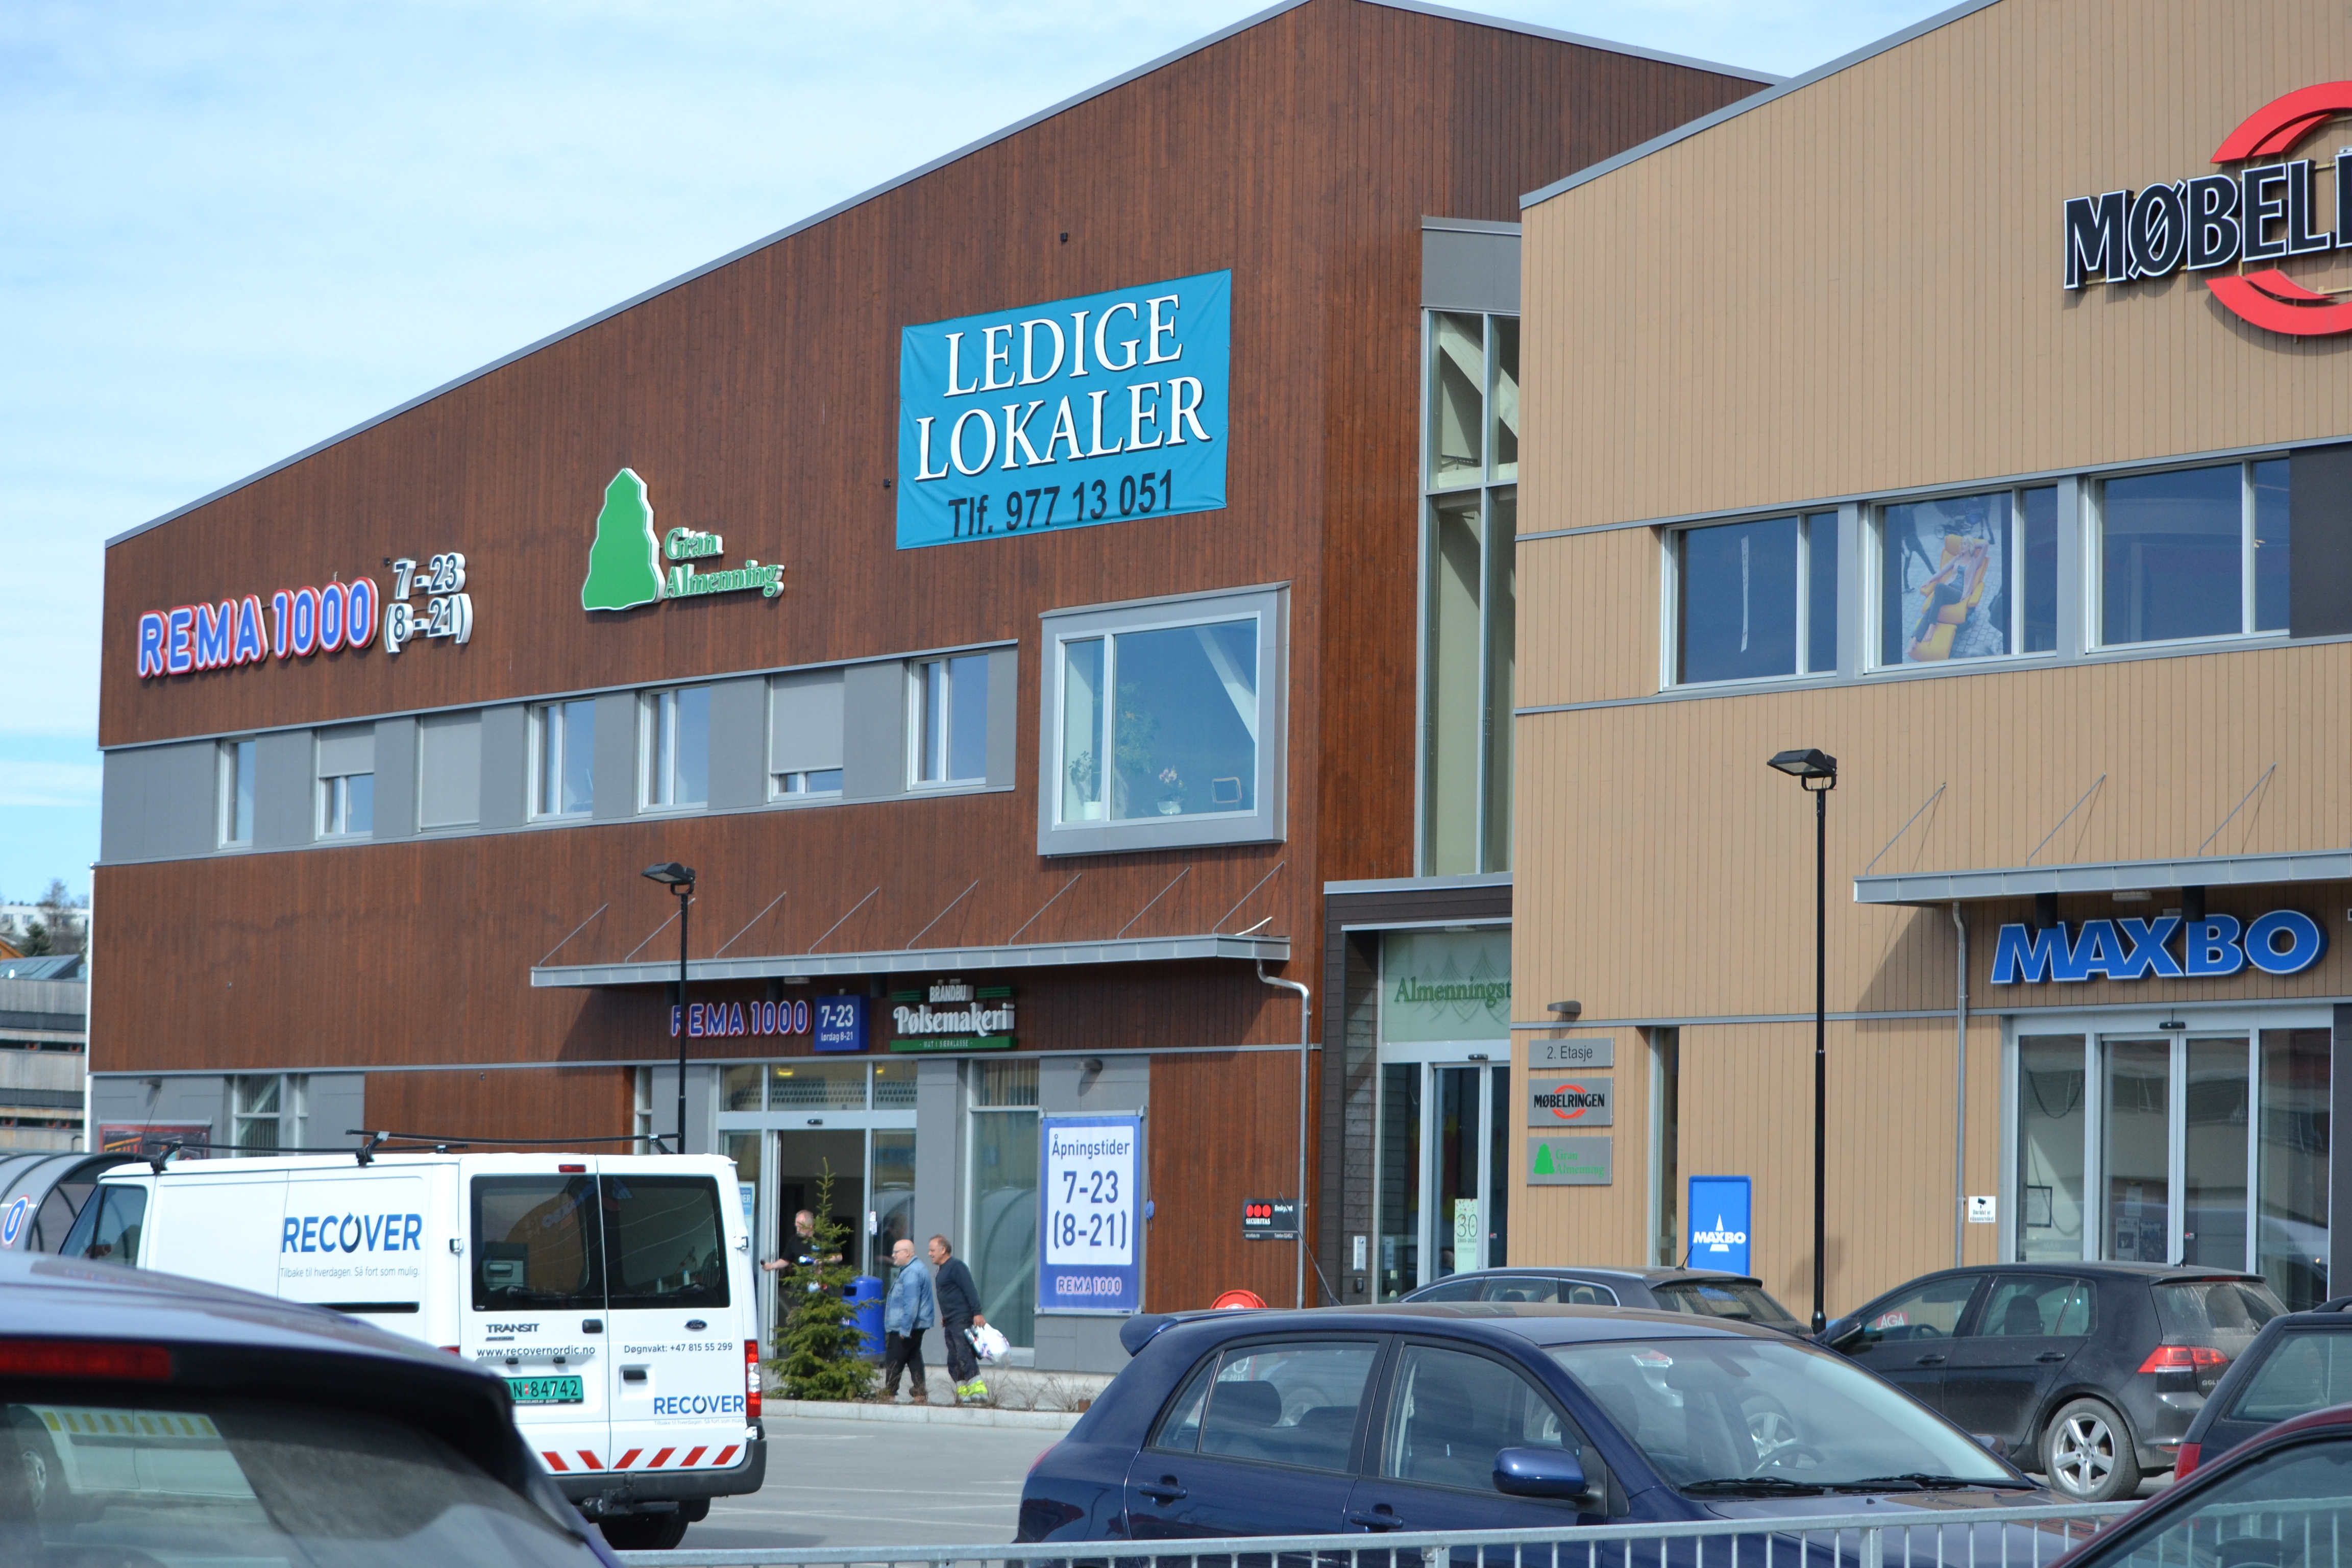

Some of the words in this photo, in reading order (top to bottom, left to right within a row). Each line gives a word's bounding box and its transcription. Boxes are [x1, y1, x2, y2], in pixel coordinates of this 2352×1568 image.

[944, 294, 1183, 398] LEDIGE
[915, 376, 1212, 482] LOKALER
[948, 495, 993, 537] Tlf.
[1007, 486, 1060, 531] 977
[1073, 479, 1107, 522] 13
[1119, 469, 1172, 516] 051
[665, 526, 721, 560] Gran
[393, 552, 465, 600] 7-23
[665, 560, 783, 598] Almenning
[137, 594, 268, 679] REMA
[272, 577, 378, 659] 1000
[383, 593, 473, 653] (8-21)
[1991, 909, 2325, 984] MAXBO
[929, 984, 971, 1002] BRANDBU
[751, 1000, 812, 1035] 1000
[821, 1004, 853, 1027] 7-23
[893, 1001, 1013, 1037] Pølsemakeri
[821, 1032, 840, 1043] lørdag
[840, 1031, 853, 1040] 8-21
[1547, 1046, 1556, 1059] 2.
[1560, 1045, 1592, 1062] Etasje
[1534, 1093, 1605, 1108] MØBELRINGEN
[1052, 1134, 1130, 1159] Åpningstider
[1555, 1148, 1578, 1160] Gran
[1556, 1163, 1605, 1178] Almenning
[1063, 1170, 1119, 1204] 7-23
[281, 1212, 423, 1254] RECOVER
[1054, 1209, 1126, 1250] (8-21)
[1457, 1214, 1478, 1237] 30
[1693, 1231, 1746, 1244] MAXBO
[280, 1267, 304, 1277] Tilbake
[314, 1267, 352, 1279] hverdagen.
[355, 1266, 363, 1277] Så
[365, 1266, 378, 1276] fort
[381, 1268, 396, 1276] som
[398, 1266, 420, 1278] mulig.
[1057, 1276, 1092, 1294] REMA
[1093, 1277, 1122, 1295] 1000
[485, 1323, 540, 1333] TRANSIT
[1880, 1312, 1905, 1328] AGA
[477, 1344, 596, 1357] www.recovernordic.no
[624, 1344, 668, 1354] Døgnvakt:
[670, 1343, 686, 1352] +47
[689, 1343, 702, 1352] 815
[705, 1343, 715, 1351] 55
[717, 1342, 733, 1351] 299
[530, 1379, 578, 1398] 84742
[654, 1394, 745, 1415] RECOVER
